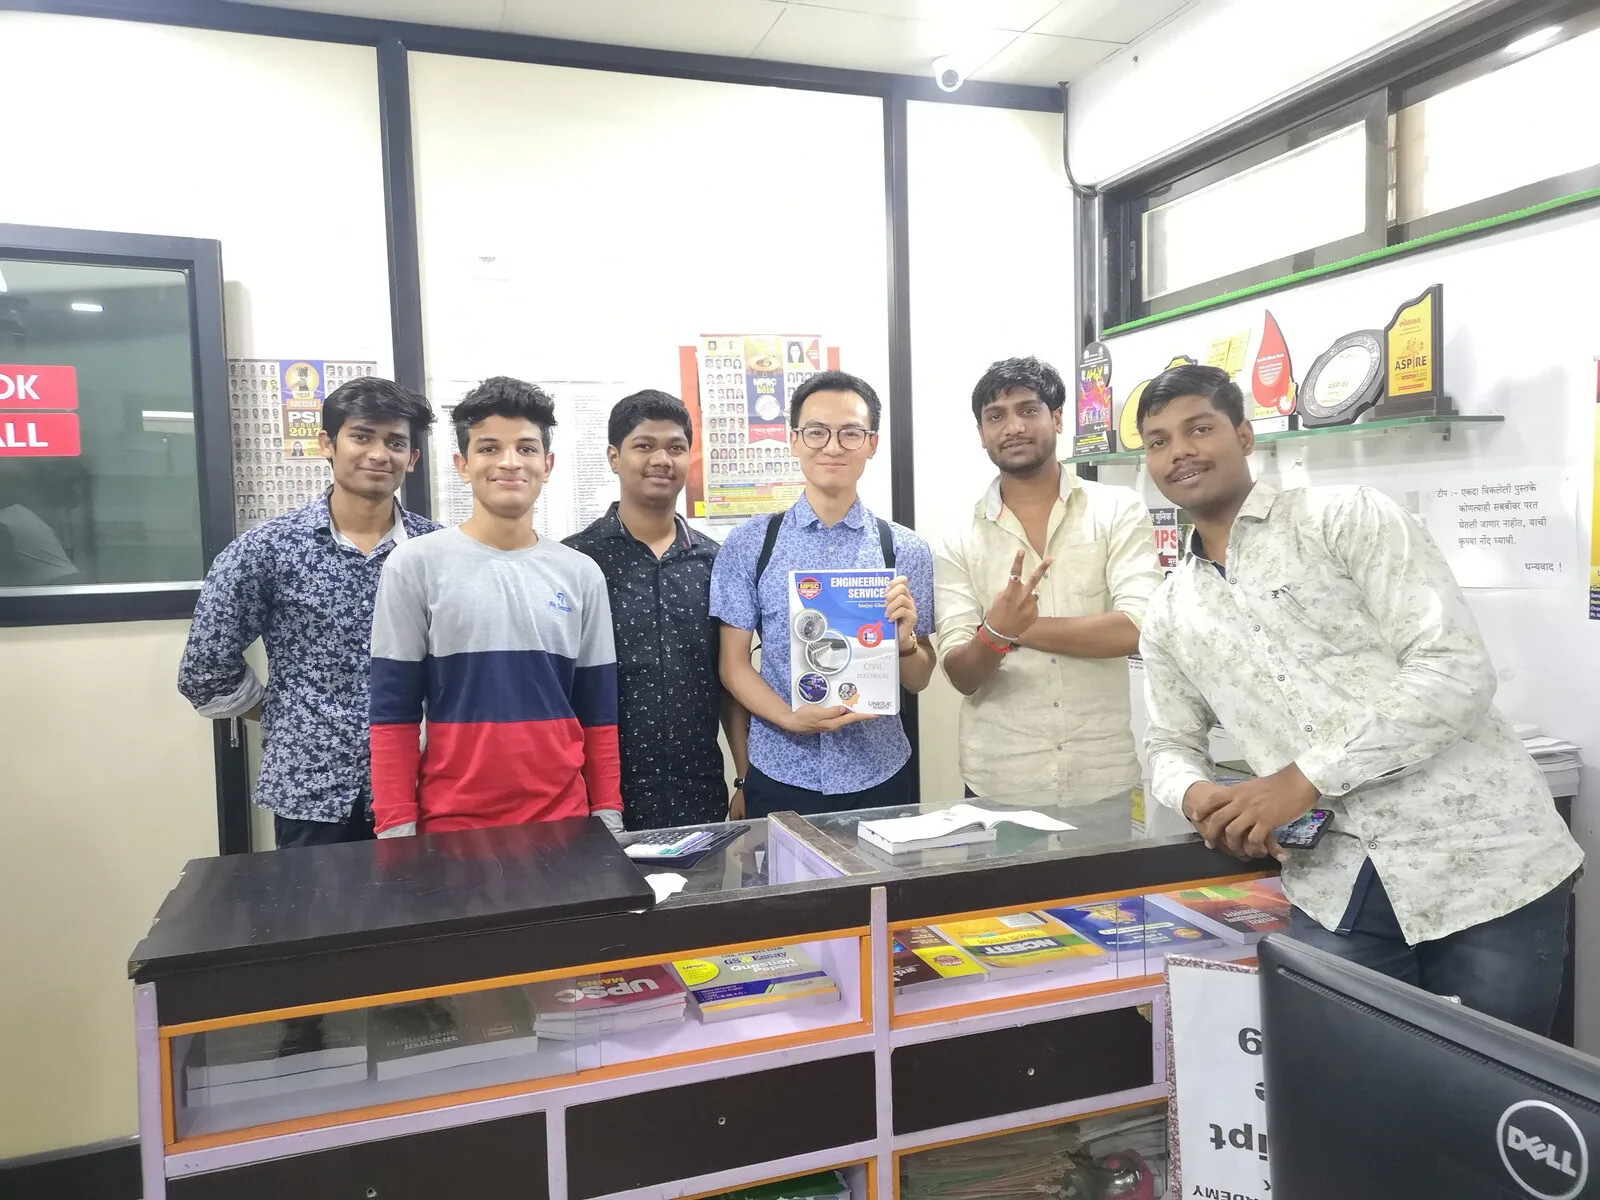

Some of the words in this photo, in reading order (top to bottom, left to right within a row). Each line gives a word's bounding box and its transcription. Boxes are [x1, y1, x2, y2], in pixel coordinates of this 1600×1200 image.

[288, 410, 320, 423] PSI
[0, 422, 48, 448] LL
[289, 428, 322, 437] 2017
[1460, 488, 1479, 498] एकदा
[1482, 484, 1512, 496] विकलेली
[1514, 481, 1537, 496] पुस्तके
[1458, 500, 1491, 513] कोणत्याही
[1524, 501, 1538, 510] परत
[1458, 518, 1478, 529] घेतली
[1480, 519, 1500, 528] जाणार
[1528, 516, 1547, 528] याची
[1525, 562, 1554, 572] धन्यवाद
[830, 576, 890, 588] ENGINEERING
[848, 588, 886, 598] SERVICE
[864, 662, 884, 670] CIVIL
[984, 938, 1058, 955] NCERT
[752, 952, 787, 961] Essay
[730, 958, 796, 971] Question
[752, 962, 799, 973] Papers
[576, 976, 625, 987] MAINS
[554, 978, 660, 1003] UPSC
[1506, 1125, 1577, 1178] DELL
